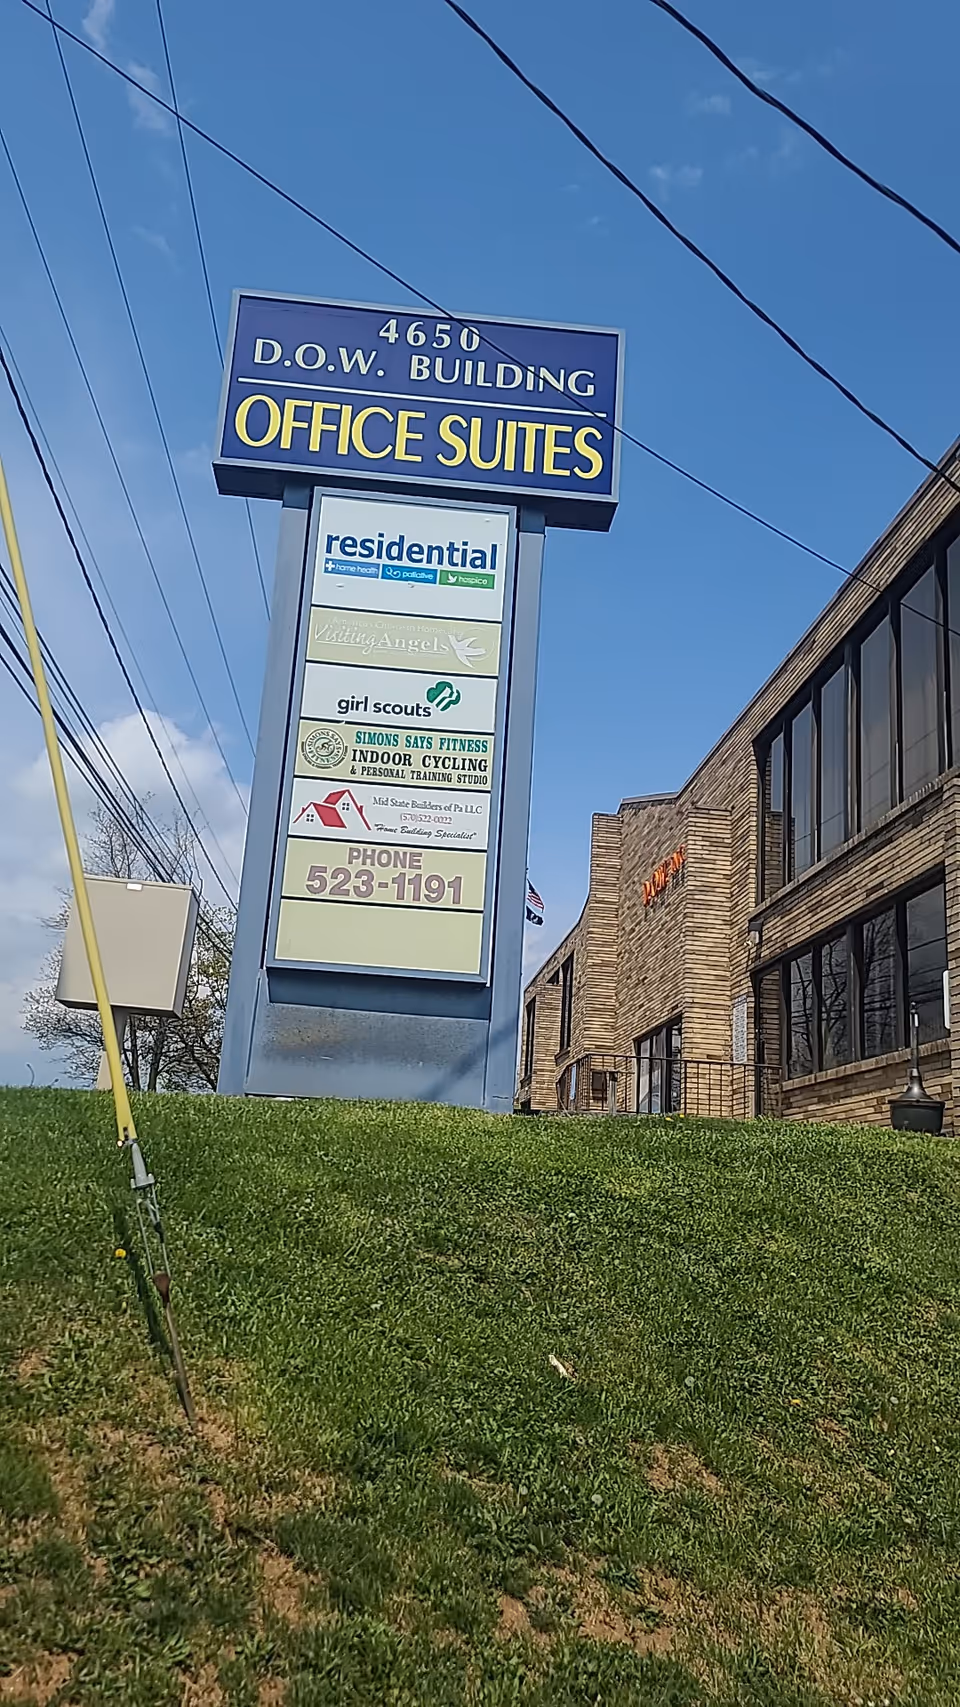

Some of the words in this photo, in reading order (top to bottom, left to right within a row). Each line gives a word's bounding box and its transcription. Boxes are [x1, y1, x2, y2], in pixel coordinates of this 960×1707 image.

[379, 319, 480, 351] 4650
[253, 338, 385, 376] D.O.W.
[410, 355, 595, 396] BUILDING
[235, 394, 426, 462] OFFICE
[436, 412, 603, 480] SUITES
[325, 532, 498, 570] residential
[335, 563, 356, 572] home
[357, 565, 379, 575] health
[458, 575, 488, 585] hospice
[337, 695, 368, 715] girl
[372, 701, 432, 717] scouts
[355, 730, 399, 747] SIMONS
[405, 735, 433, 750] SAYS
[438, 737, 488, 753] FITNESS
[351, 749, 413, 767] INDOOR
[421, 755, 488, 772] CYCLING
[350, 765, 357, 775] &
[360, 766, 406, 779] PERSONAL
[410, 770, 453, 783] TRAINING
[456, 774, 488, 786] STUDIO
[372, 796, 389, 806] Mid
[390, 798, 410, 808] State
[411, 800, 442, 811] Builders
[443, 804, 452, 812] of
[464, 805, 483, 814] LLC
[400, 825, 432, 838] Building
[347, 847, 423, 870] PHONE
[305, 865, 463, 905] 523-1191
